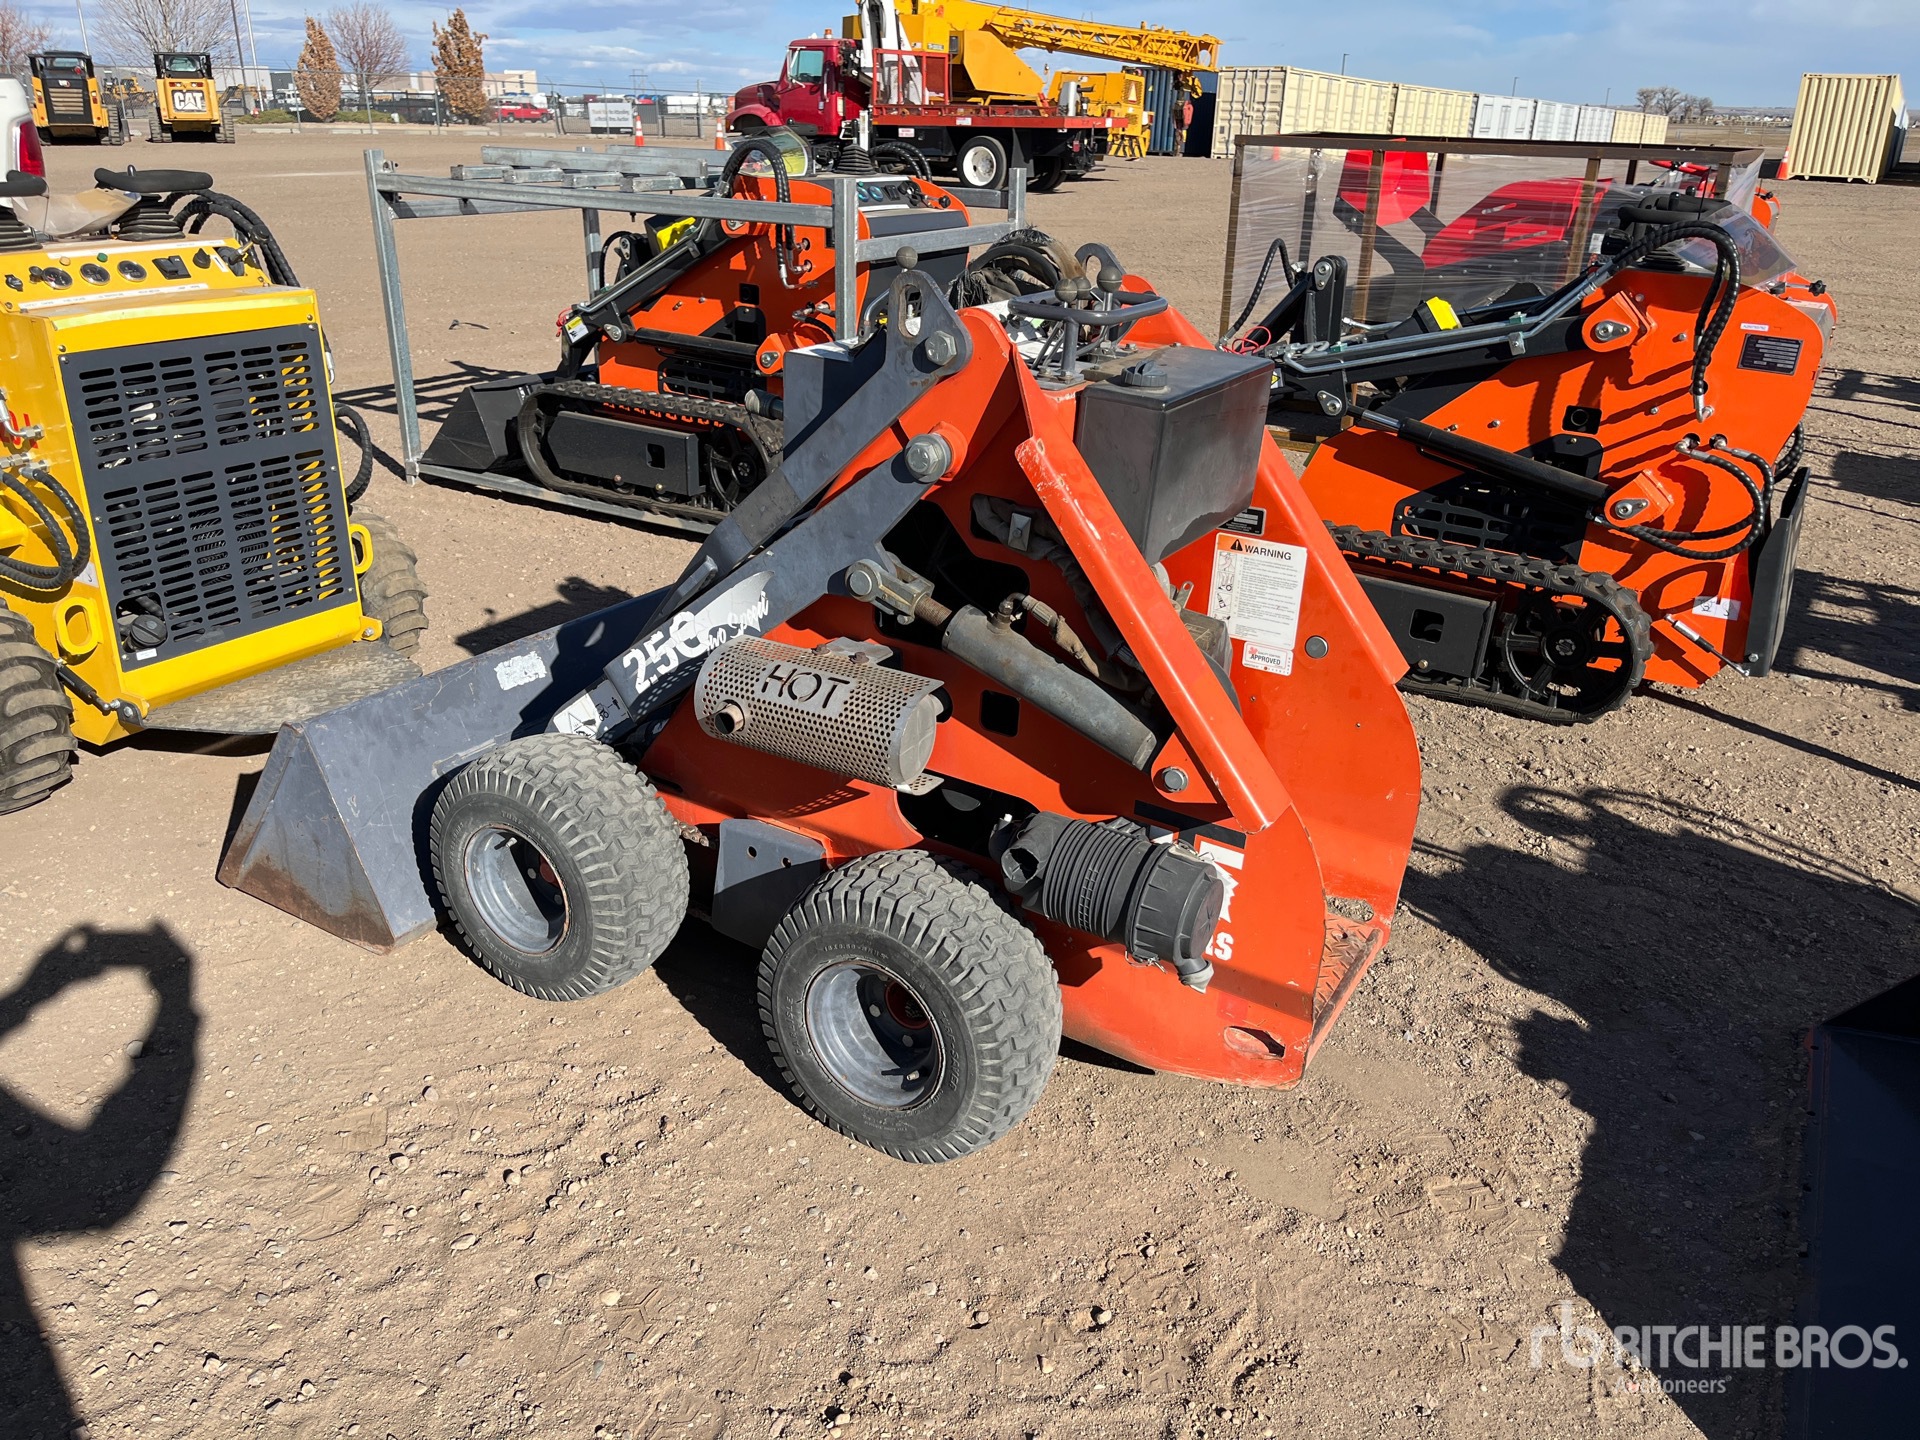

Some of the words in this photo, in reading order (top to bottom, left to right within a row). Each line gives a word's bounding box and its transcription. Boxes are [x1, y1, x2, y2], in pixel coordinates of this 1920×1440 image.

[174, 92, 203, 110] CAT
[1244, 544, 1292, 561] WARNING
[1250, 654, 1281, 665] APPROVED
[761, 664, 851, 709] HOT
[940, 1010, 961, 1092] TURF-SAVER
